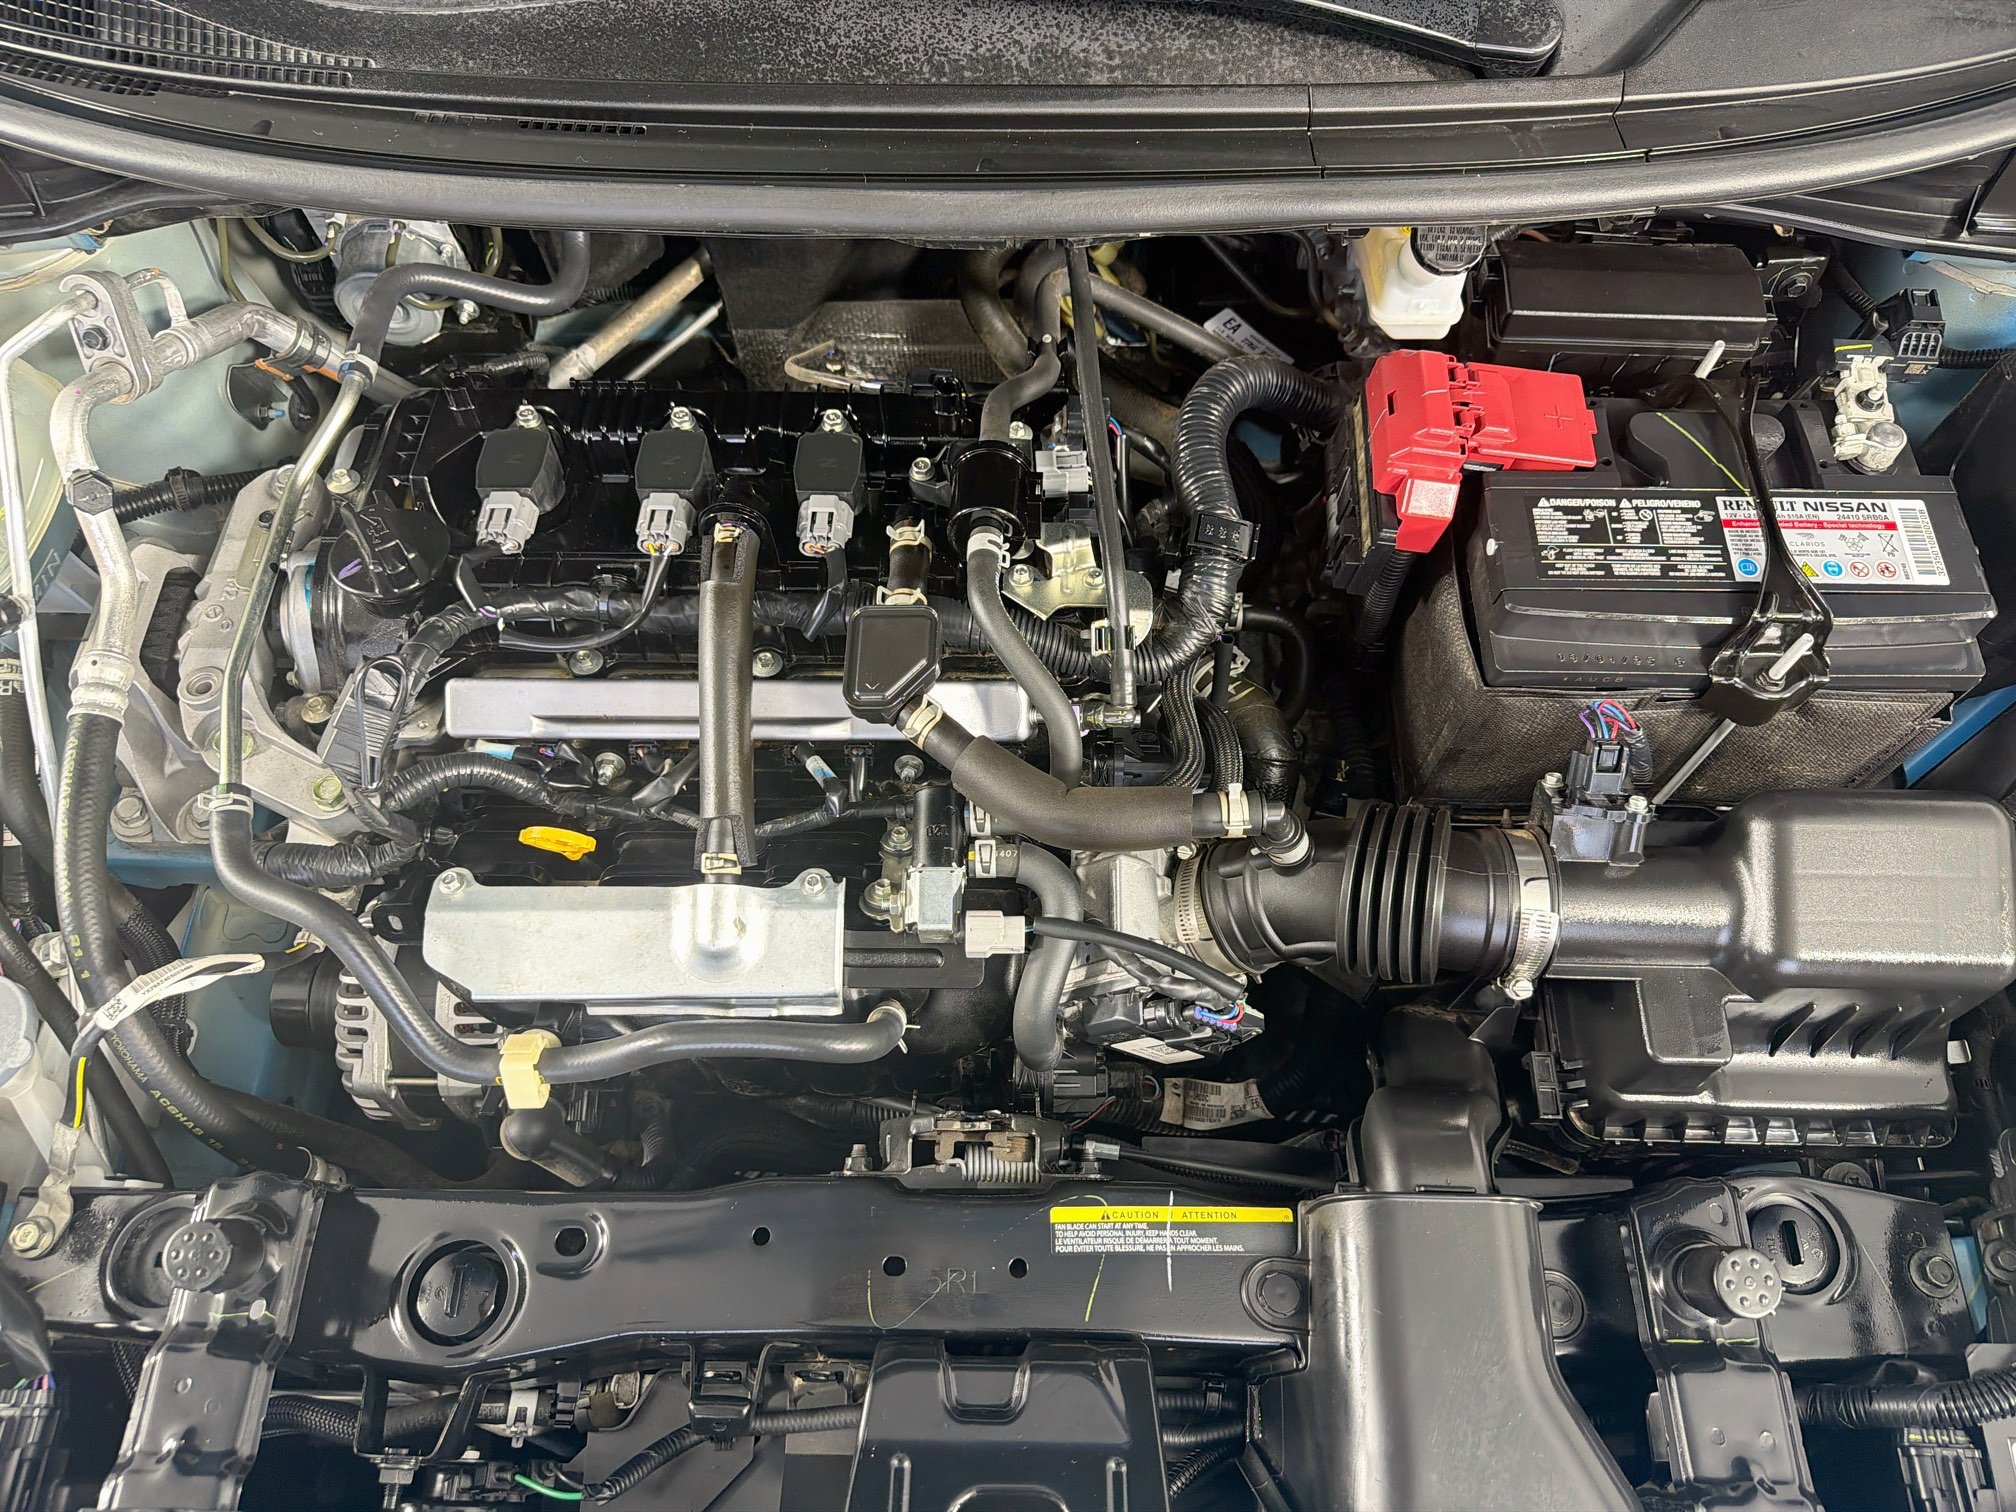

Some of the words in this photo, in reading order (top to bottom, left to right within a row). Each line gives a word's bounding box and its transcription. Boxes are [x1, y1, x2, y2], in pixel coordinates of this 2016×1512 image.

[1222, 317, 1243, 335] EA
[1549, 498, 1617, 507] DANGER/POISON
[1631, 499, 1701, 508] PELIGRO/VENENO
[1803, 501, 1887, 512] NISSAN
[1805, 513, 1820, 521] (EN)
[1836, 513, 1860, 521] 24410
[1793, 521, 1818, 529] Battery
[1823, 521, 1848, 530] Special
[1848, 522, 1886, 530] technology
[110, 1034, 147, 1083] YOKOHAMA
[1112, 1211, 1159, 1219] CAUTION
[1182, 1211, 1237, 1220] ATTENTION
[1055, 1230, 1064, 1238] TO
[1064, 1230, 1078, 1238] HELP
[1079, 1230, 1096, 1238] AVOID
[1096, 1230, 1124, 1238] PERSONAL
[1063, 1237, 1103, 1245] VENTILATEUR
[1104, 1237, 1126, 1245] RISQUE
[1135, 1236, 1168, 1244] DÉMARRER
[1074, 1244, 1094, 1253] ÉVITER
